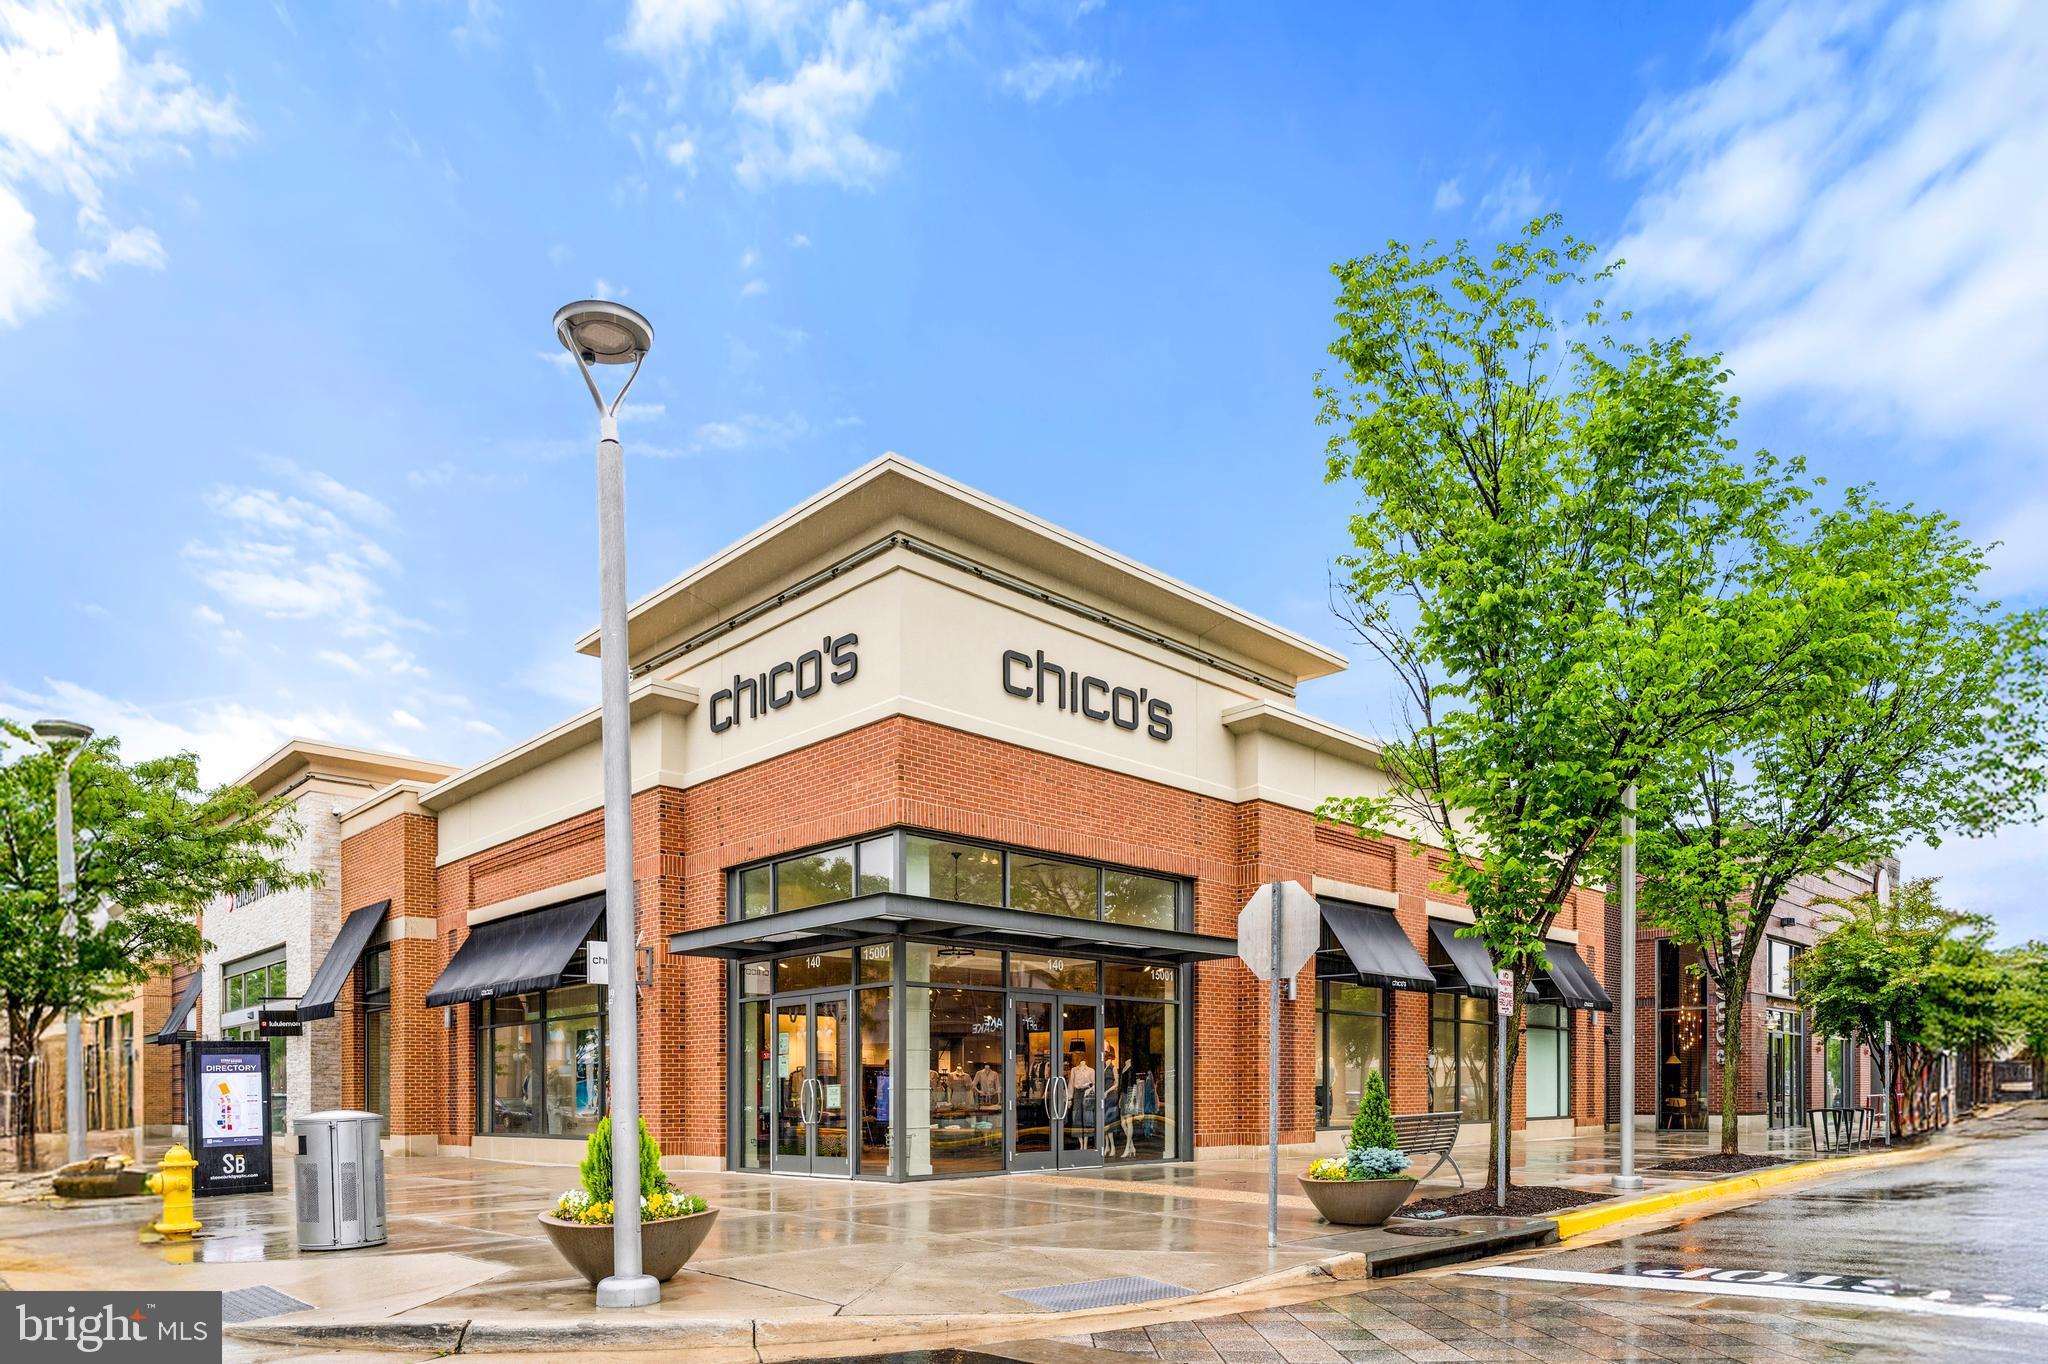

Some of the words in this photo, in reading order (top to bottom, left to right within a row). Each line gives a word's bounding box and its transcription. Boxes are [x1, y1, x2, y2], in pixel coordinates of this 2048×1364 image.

[710, 632, 859, 734] chico's
[1003, 649, 1173, 742] chico's
[863, 945, 891, 961] 15001
[592, 956, 608, 965] chi
[806, 955, 821, 969] 140
[1047, 959, 1064, 971] 140
[1150, 969, 1174, 982] 15001
[206, 1064, 257, 1072] DIRECTORY
[1642, 1267, 1899, 1295] STOP
